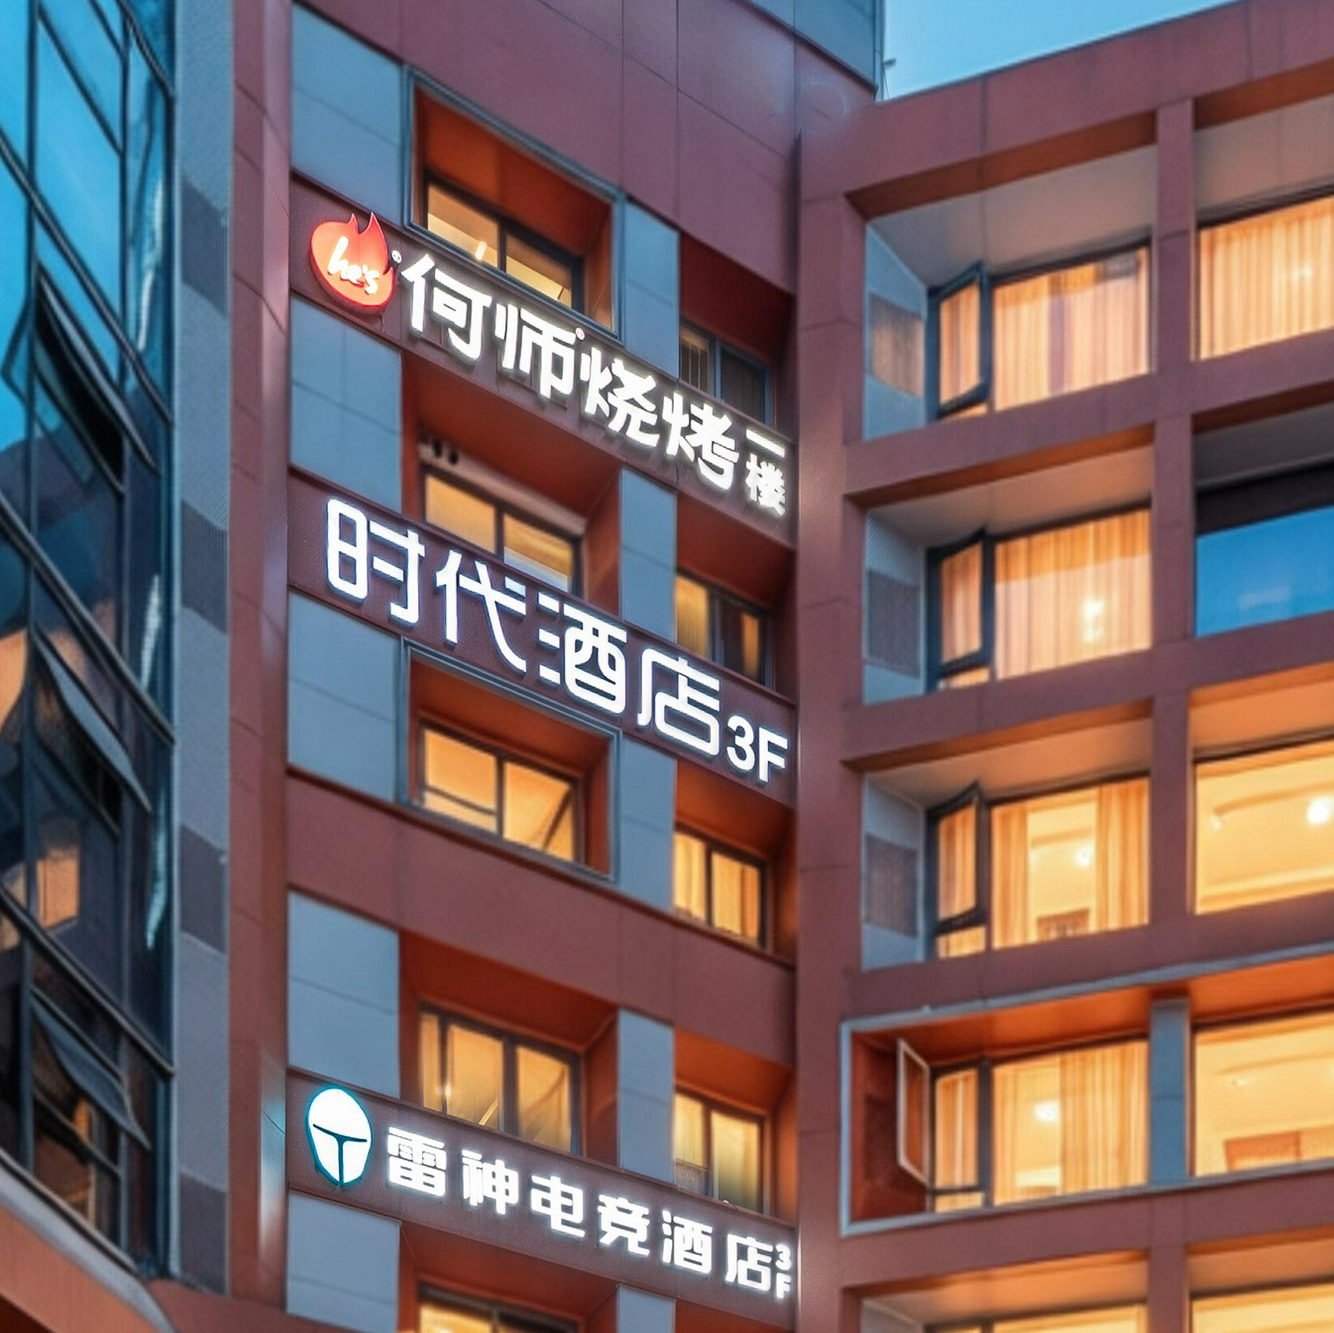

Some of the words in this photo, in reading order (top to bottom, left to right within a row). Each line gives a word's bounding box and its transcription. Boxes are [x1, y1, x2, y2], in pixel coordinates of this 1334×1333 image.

[327, 236, 380, 294] he's
[401, 253, 741, 492] 何师烧烤
[325, 498, 720, 757] 时代酒店
[725, 714, 789, 783] 3F
[387, 1126, 772, 1292] 雷神电竞酒店
